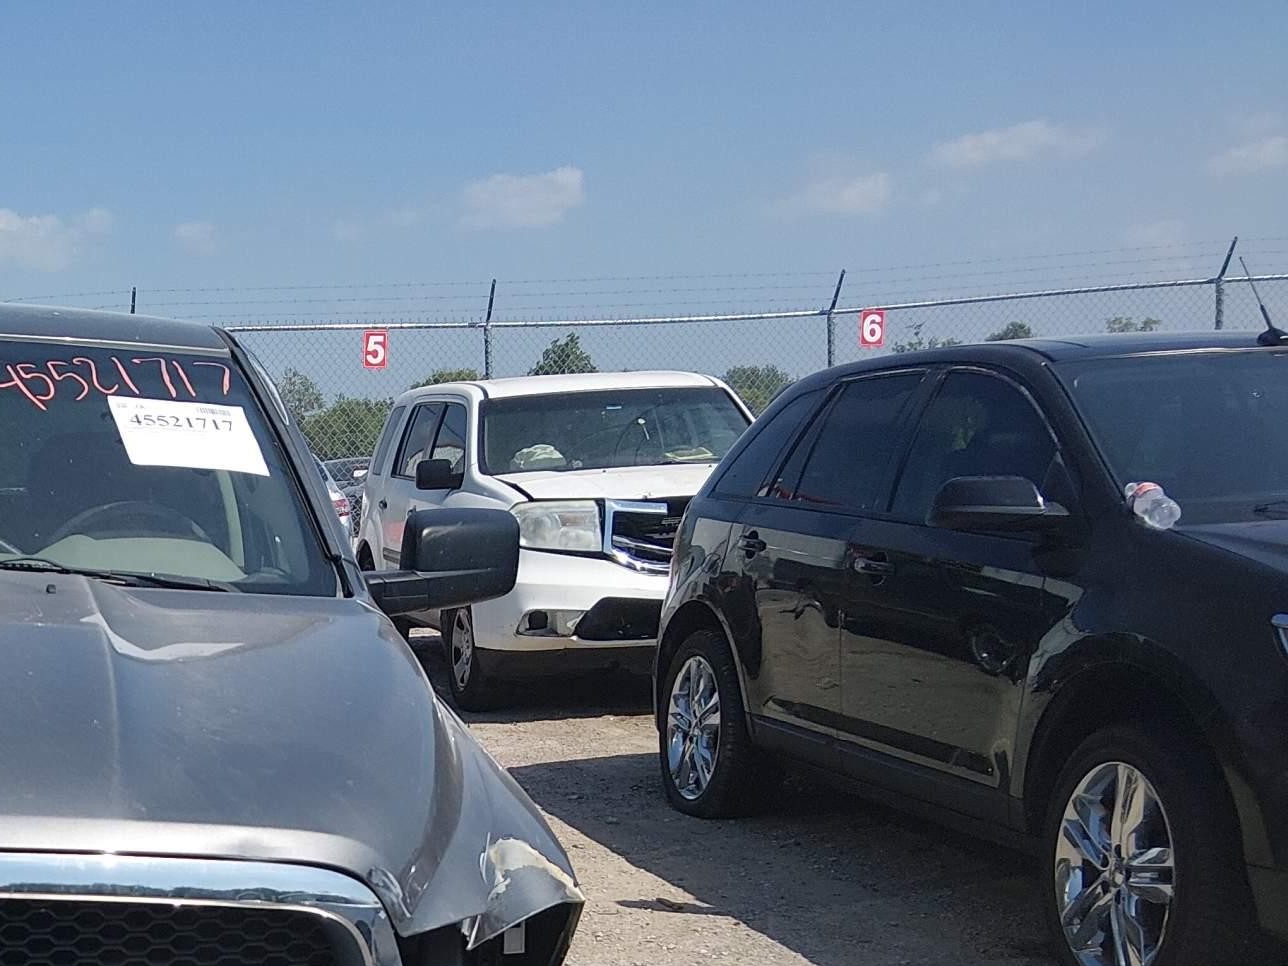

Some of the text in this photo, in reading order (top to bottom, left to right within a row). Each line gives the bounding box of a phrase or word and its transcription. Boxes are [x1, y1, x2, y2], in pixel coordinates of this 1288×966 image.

[863, 313, 882, 343] 6
[366, 335, 385, 365] 5
[130, 413, 232, 431] 45521717
